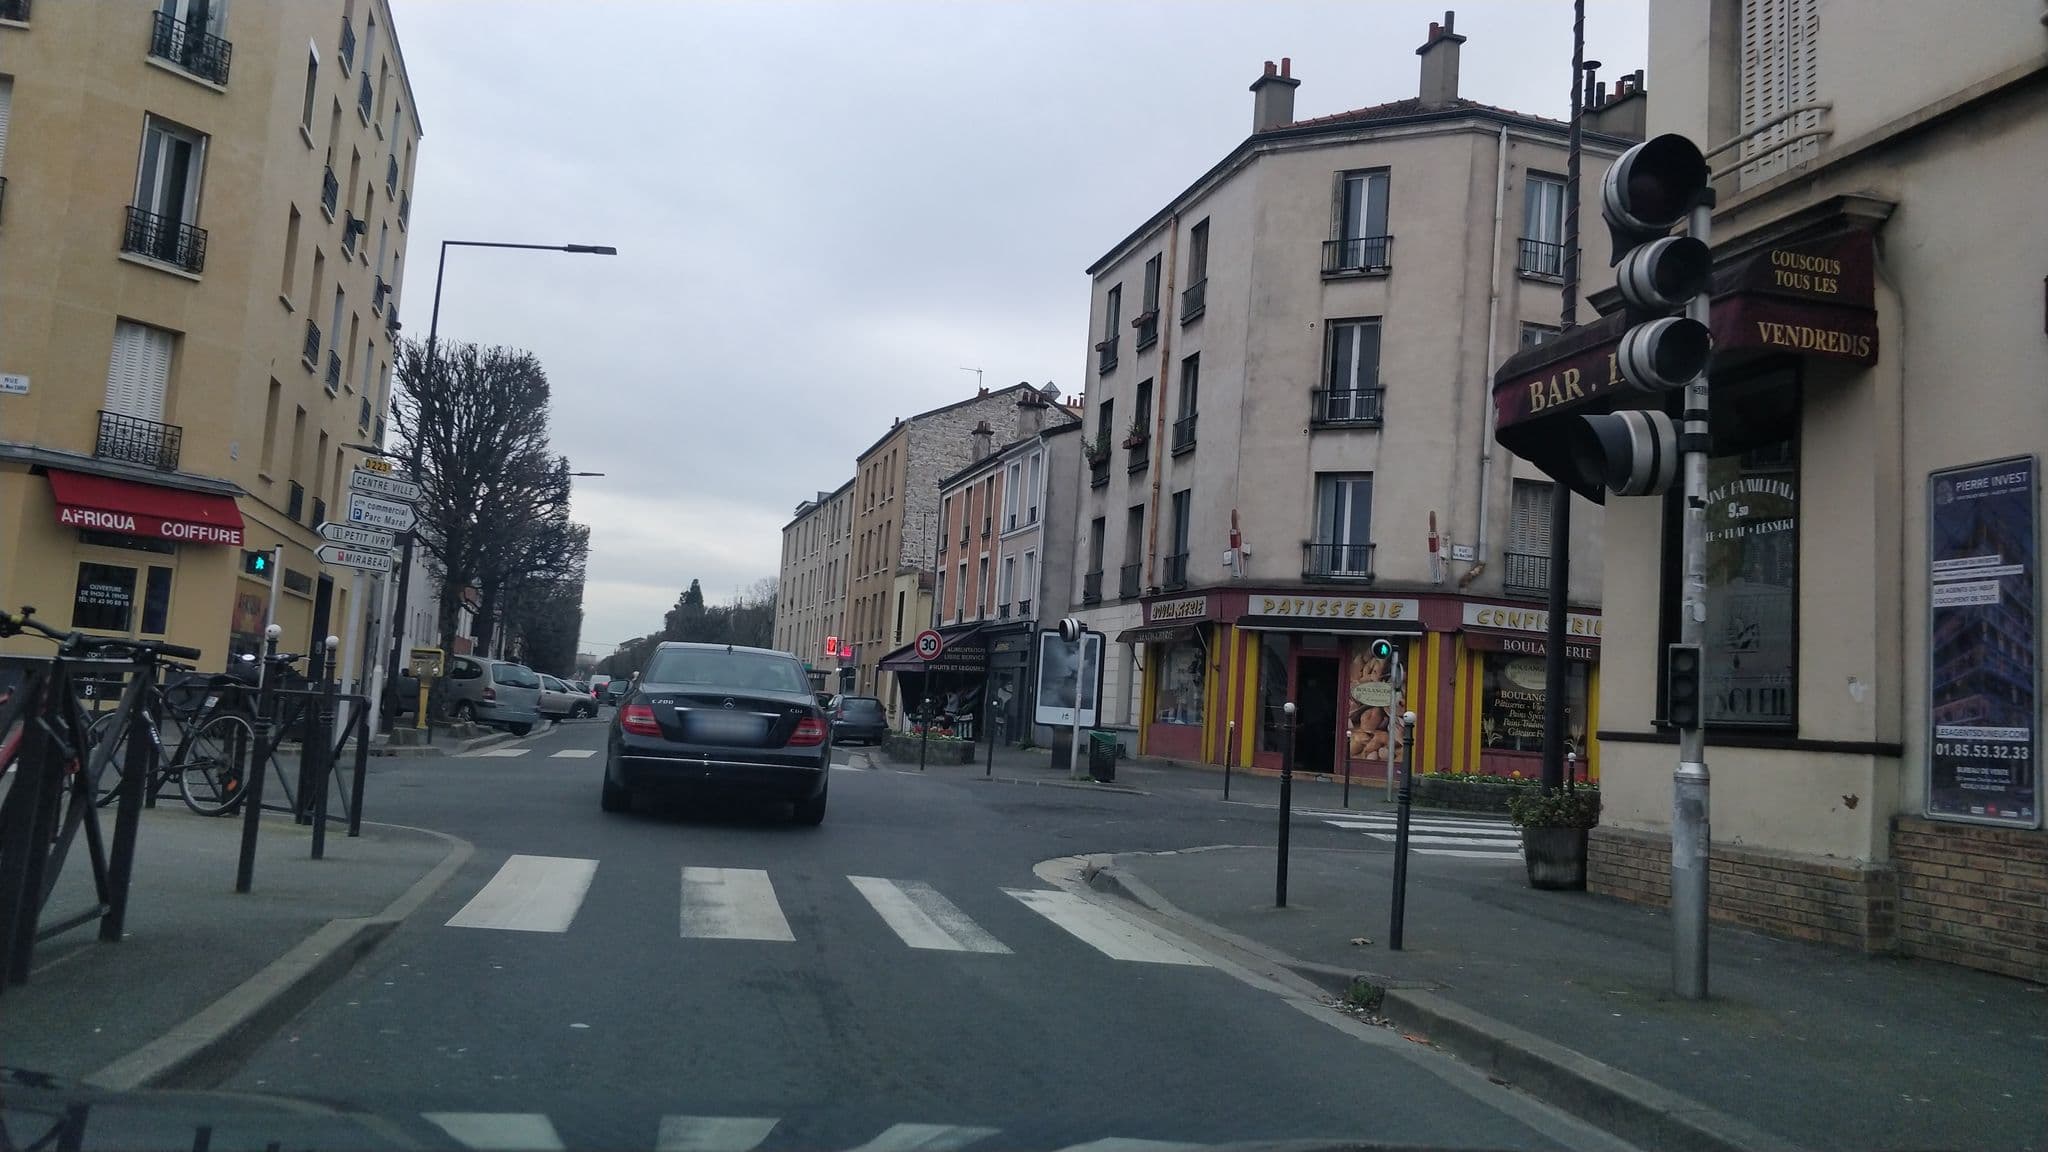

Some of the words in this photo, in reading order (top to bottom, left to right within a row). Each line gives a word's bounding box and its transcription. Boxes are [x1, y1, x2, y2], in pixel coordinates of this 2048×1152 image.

[1771, 249, 1840, 276] COUSCOUS
[1774, 269, 1811, 290] TOUS
[1813, 276, 1838, 294] LES
[1757, 321, 1870, 358] VENDREDIS
[1529, 367, 1585, 414] BAR
[356, 476, 389, 491] CENTRE
[392, 483, 414, 497] VILLE
[1955, 477, 1990, 491] PIERRE
[1990, 471, 2028, 487] INVEST
[364, 511, 381, 523] Parc
[367, 502, 408, 517] commercial
[61, 508, 136, 531] AFRIQUA
[161, 521, 241, 544] COIFFURE
[344, 530, 368, 541] PETIT
[371, 535, 391, 549] IVRY
[345, 553, 389, 568] MIRABEAU
[1263, 599, 1404, 619] PATISSERIE
[921, 638, 937, 651] 30
[1503, 639, 1592, 659] BOULAERIE
[1935, 743, 2029, 760] 01.85.53.32.33
